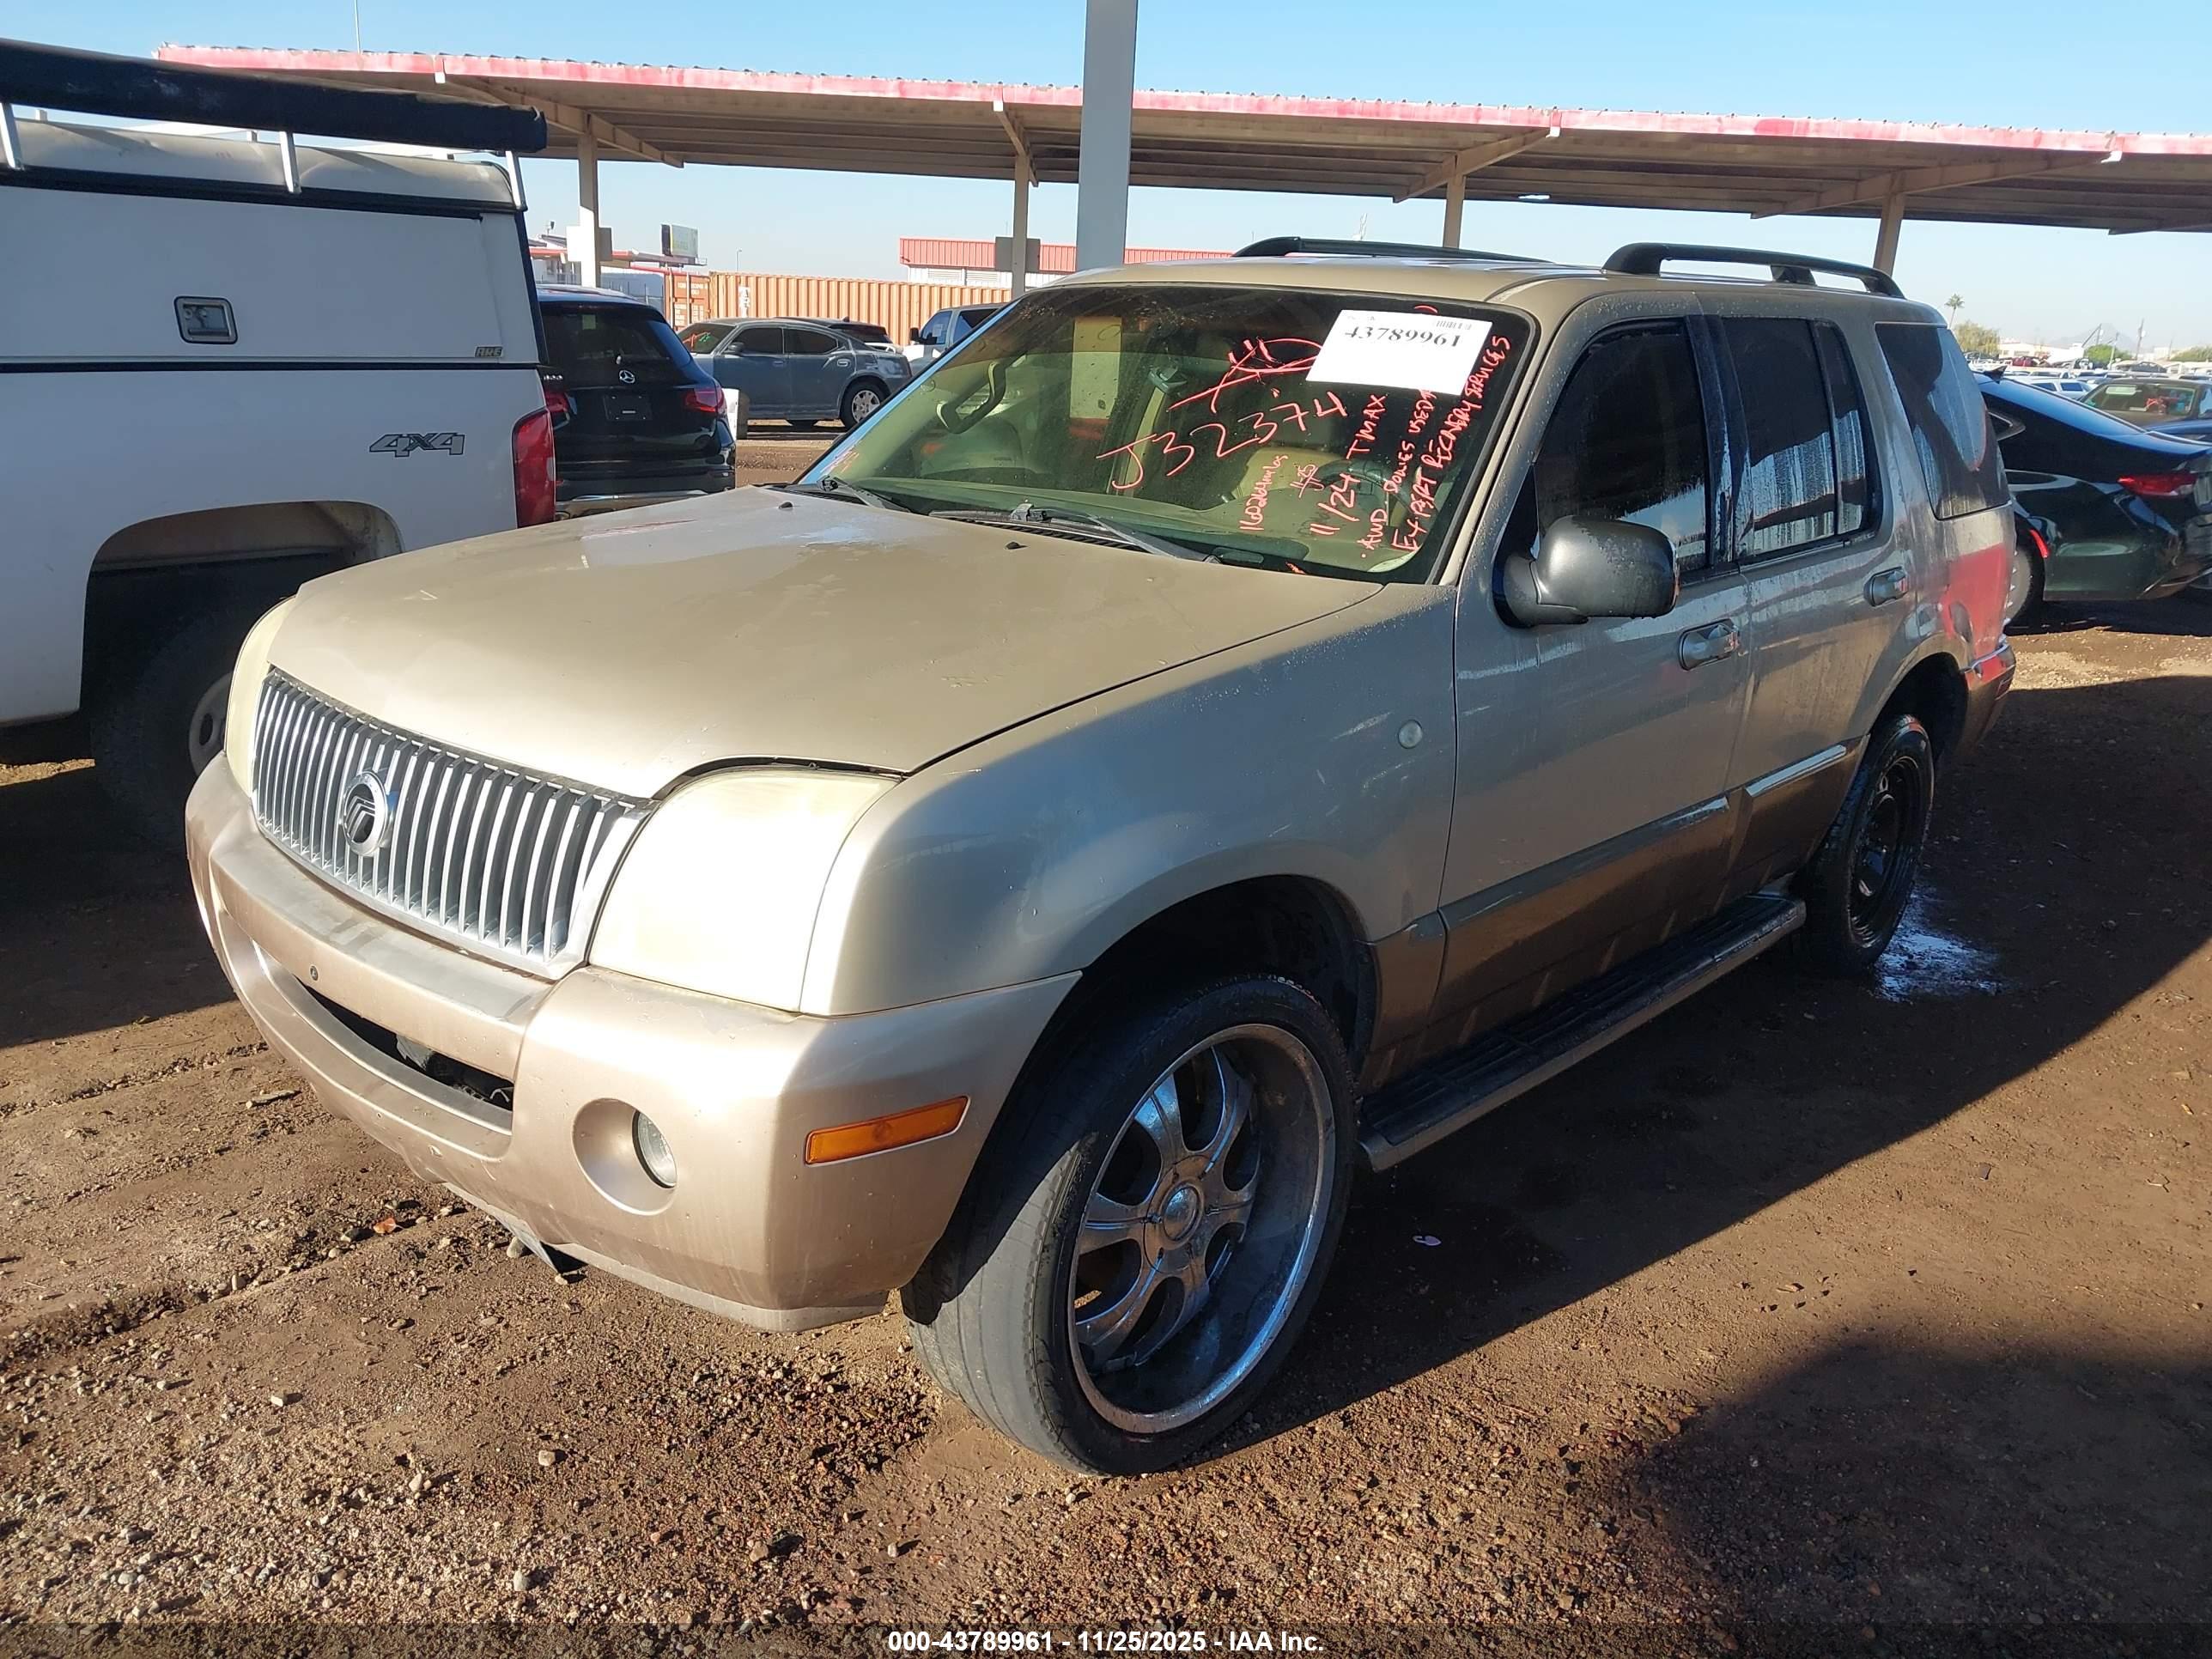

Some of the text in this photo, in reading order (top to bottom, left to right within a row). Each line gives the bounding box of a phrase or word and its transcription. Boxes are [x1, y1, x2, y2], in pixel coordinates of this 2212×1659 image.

[1344, 325, 1462, 348] 43789961
[1095, 391, 1348, 489] J32374
[1346, 393, 1387, 460] TMAX
[1357, 507, 1388, 550] AWD
